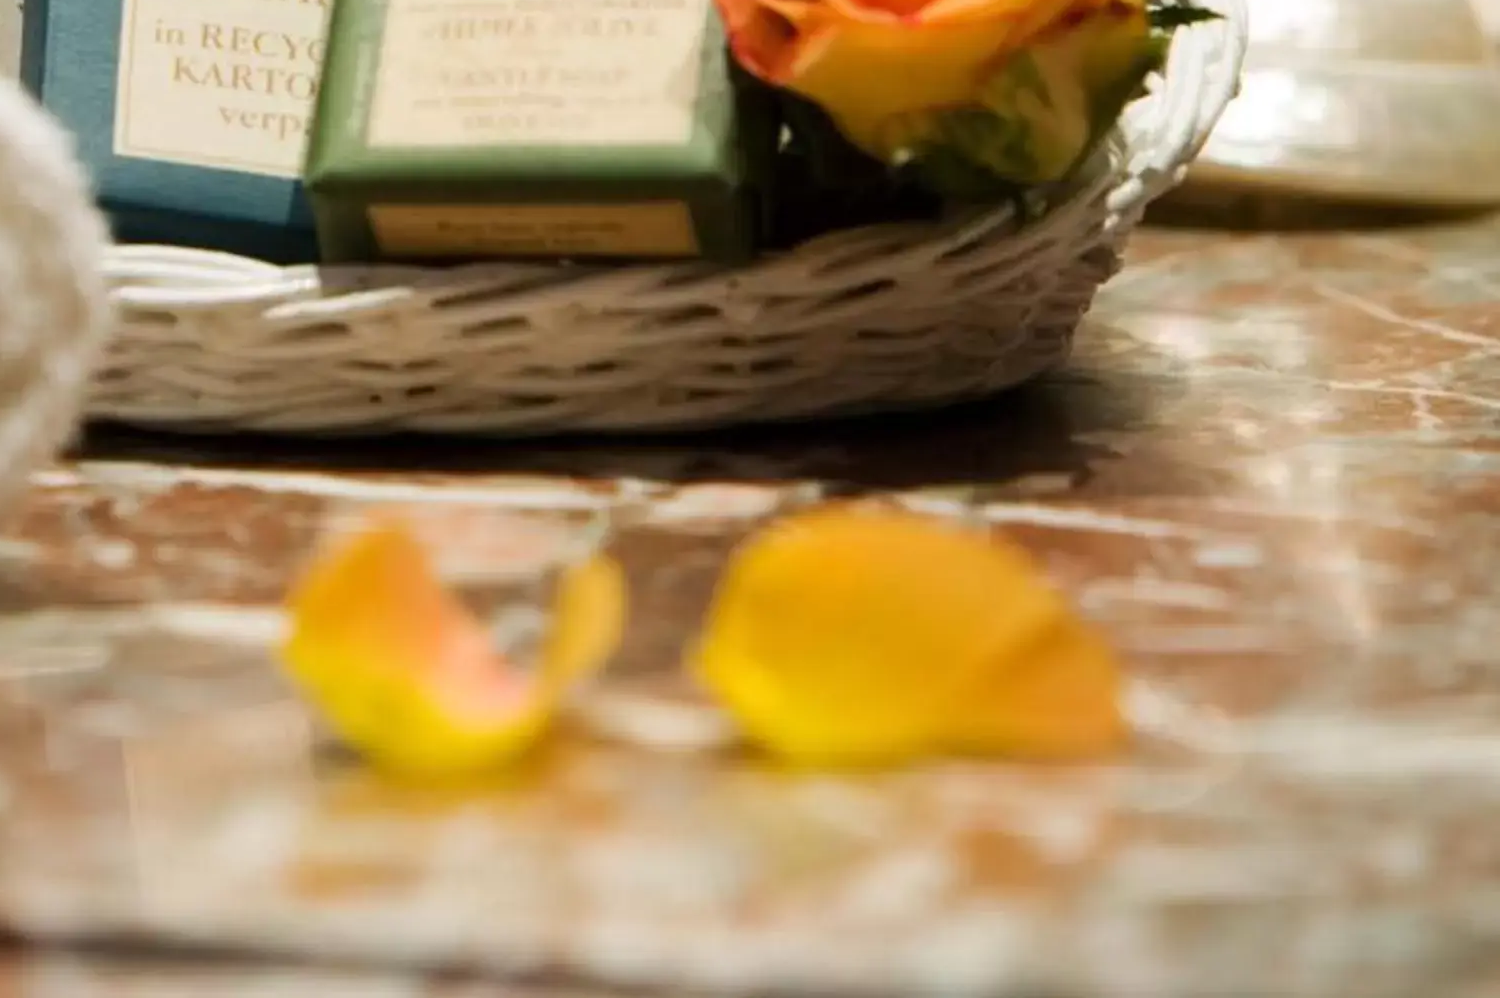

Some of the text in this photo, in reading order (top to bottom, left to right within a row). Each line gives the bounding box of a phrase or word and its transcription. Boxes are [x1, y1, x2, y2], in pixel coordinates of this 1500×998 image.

[154, 18, 185, 45] in
[172, 56, 318, 101] KARTO
[219, 106, 311, 141] verp
